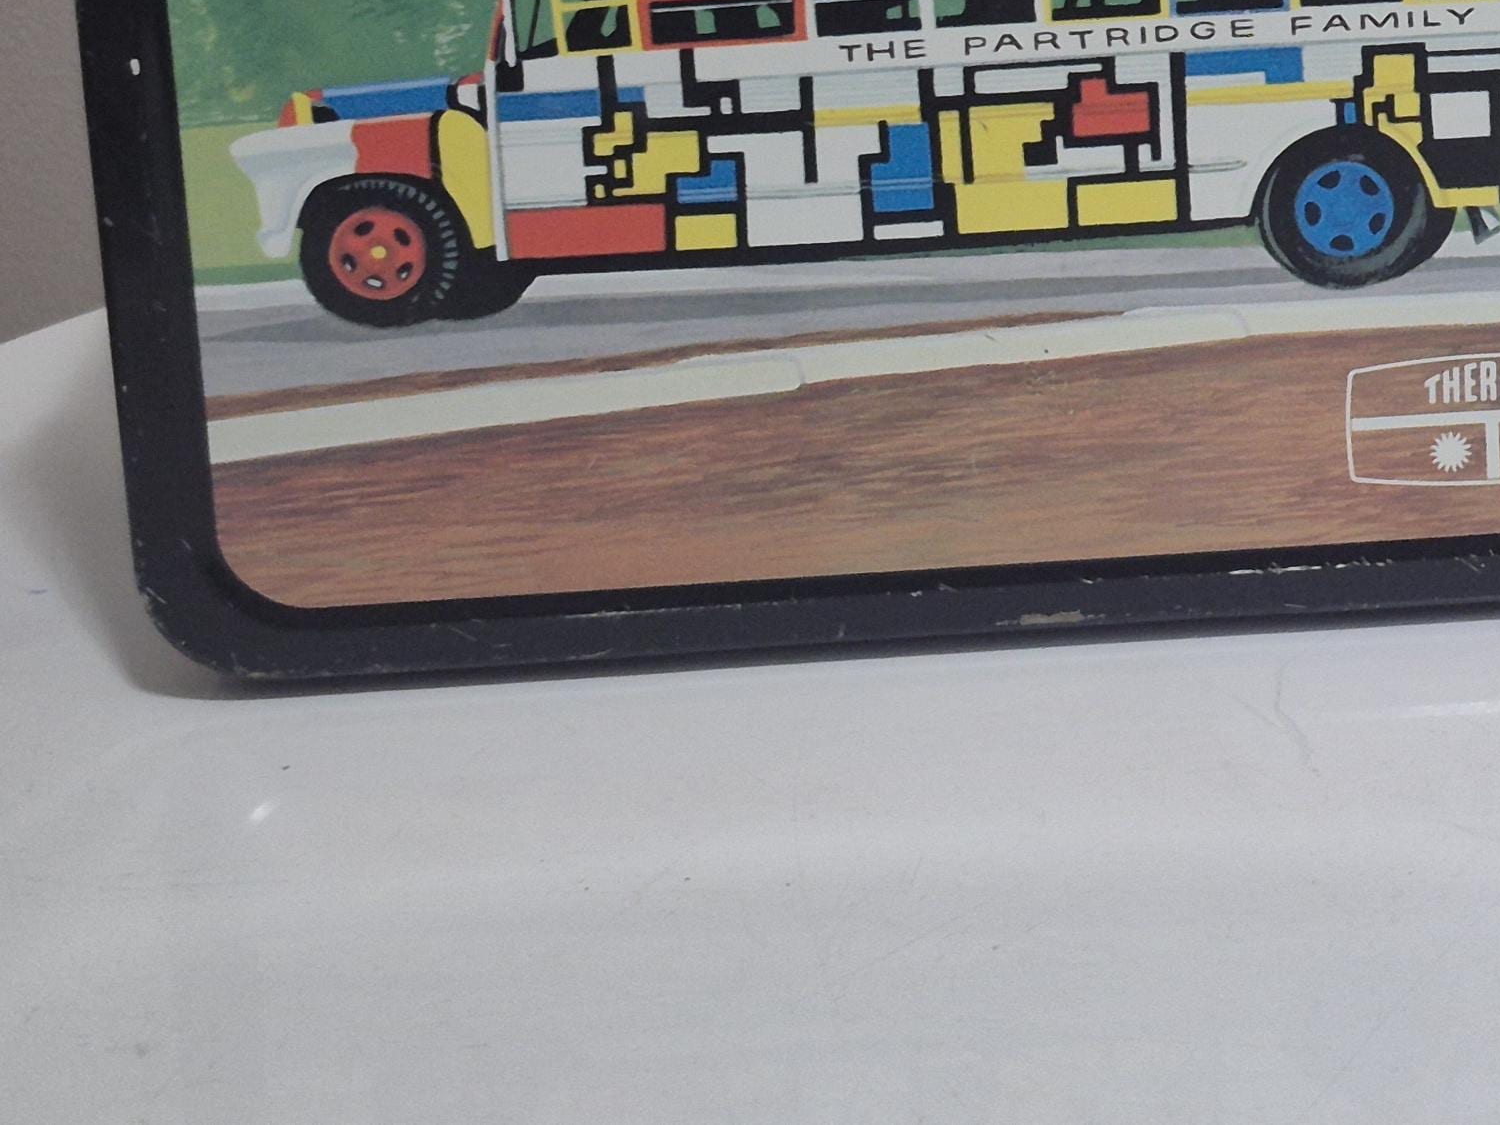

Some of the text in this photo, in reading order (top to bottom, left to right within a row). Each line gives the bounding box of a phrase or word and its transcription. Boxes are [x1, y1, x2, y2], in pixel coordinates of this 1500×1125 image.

[839, 7, 1475, 63] THE PARTRIDGE FAMILY
